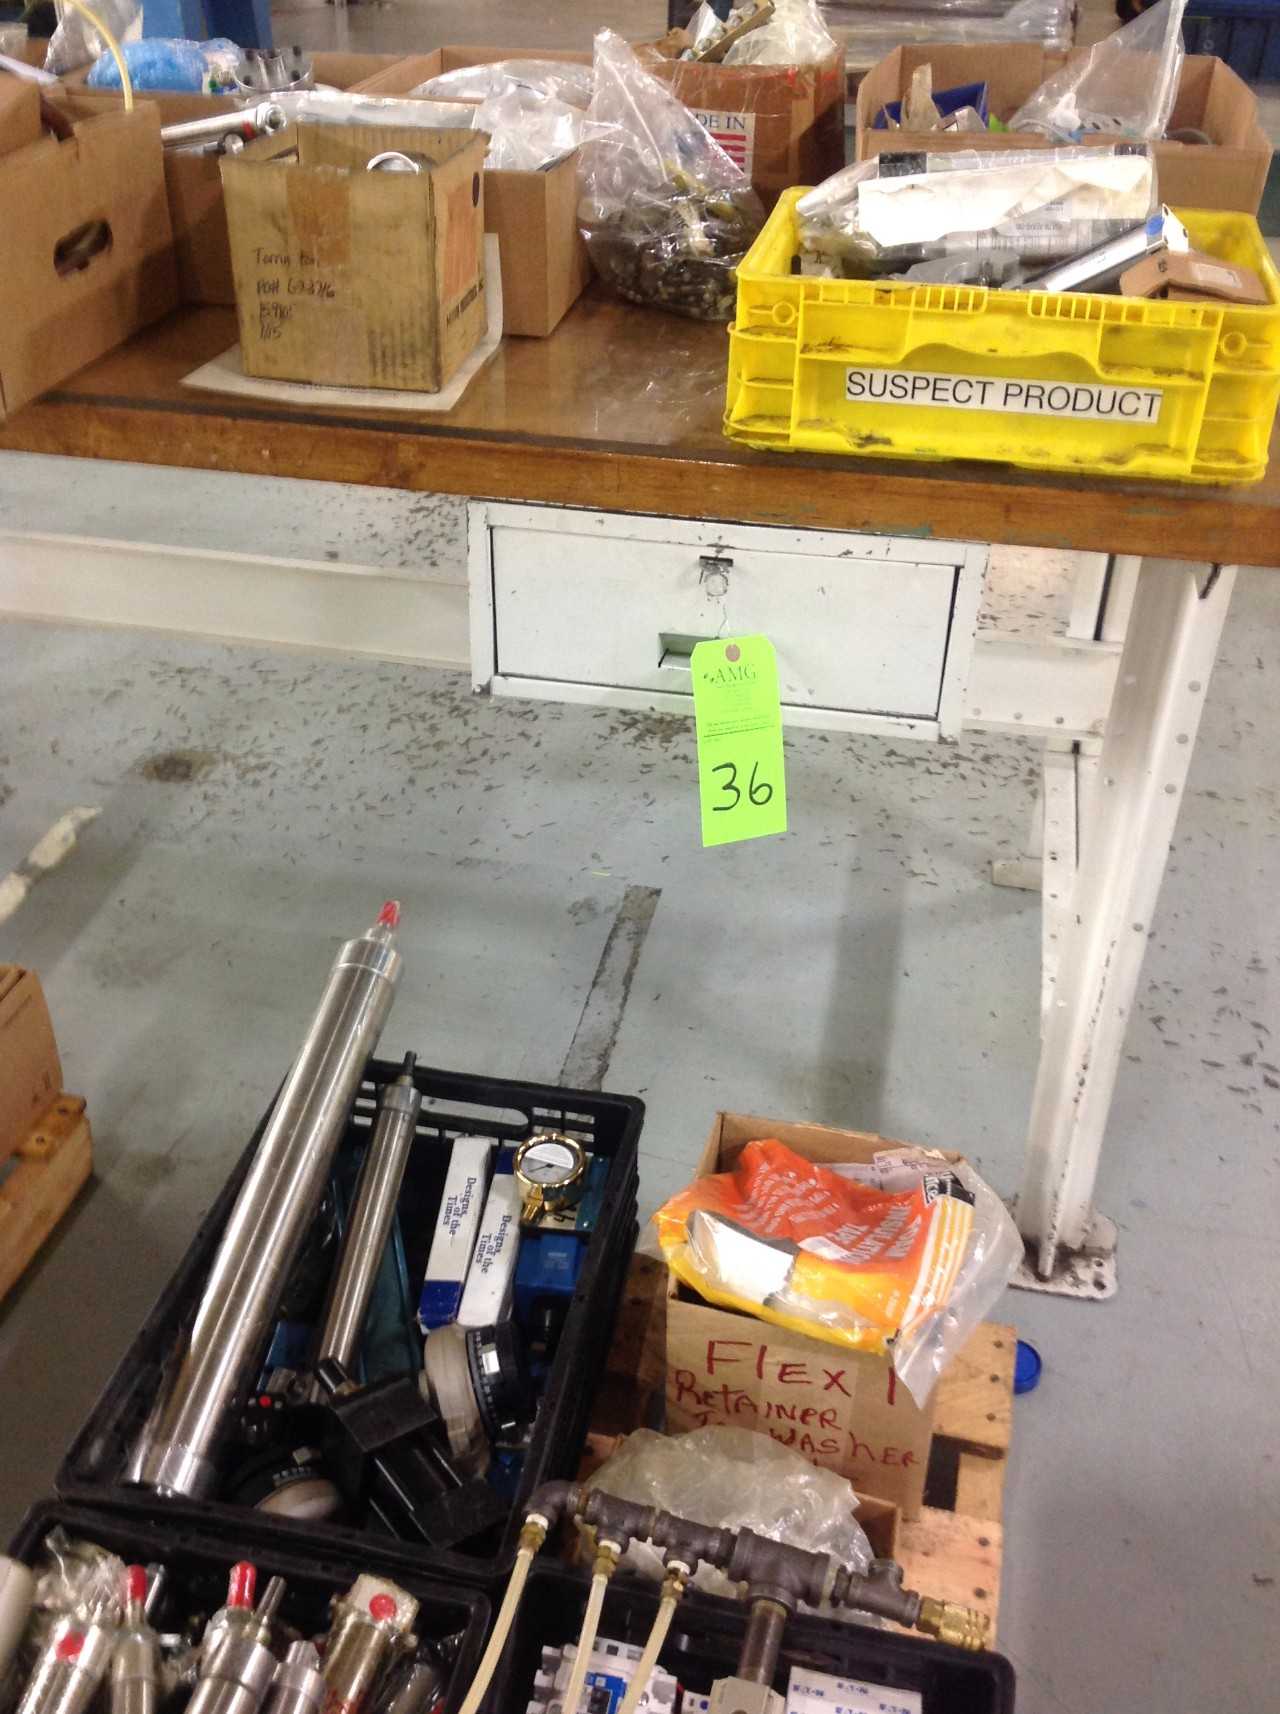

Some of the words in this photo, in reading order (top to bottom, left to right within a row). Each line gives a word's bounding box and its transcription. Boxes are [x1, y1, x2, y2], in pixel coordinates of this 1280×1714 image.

[696, 113, 720, 128] DE
[726, 116, 745, 129] IN
[847, 371, 994, 405] SUSPECT
[1003, 383, 1163, 418] PRODUCT
[712, 761, 773, 811] 36
[443, 1195, 457, 1225] Times
[461, 1177, 477, 1215] Designs
[449, 1219, 461, 1236] the
[494, 1215, 512, 1253] Designs
[476, 1234, 492, 1264] Times
[481, 1257, 494, 1274] the
